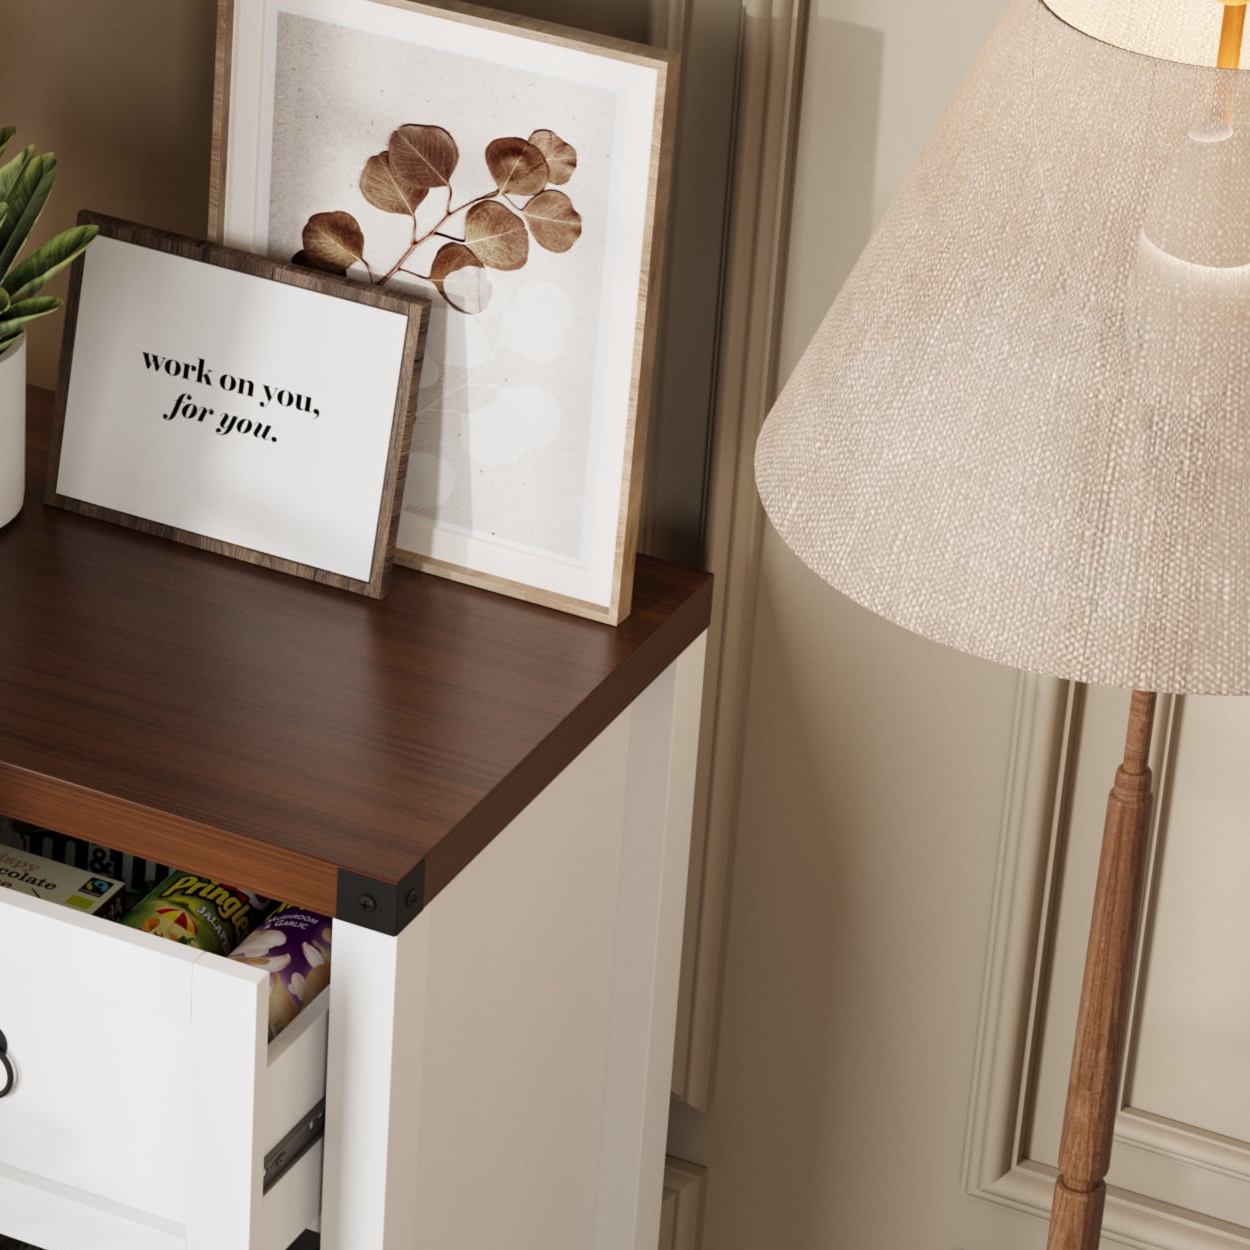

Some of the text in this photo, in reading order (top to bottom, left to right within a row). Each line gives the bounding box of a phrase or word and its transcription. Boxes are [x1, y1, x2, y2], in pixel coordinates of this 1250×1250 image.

[142, 351, 321, 420] work on you,
[163, 392, 279, 443] for you.
[274, 919, 310, 930] GARLIC
